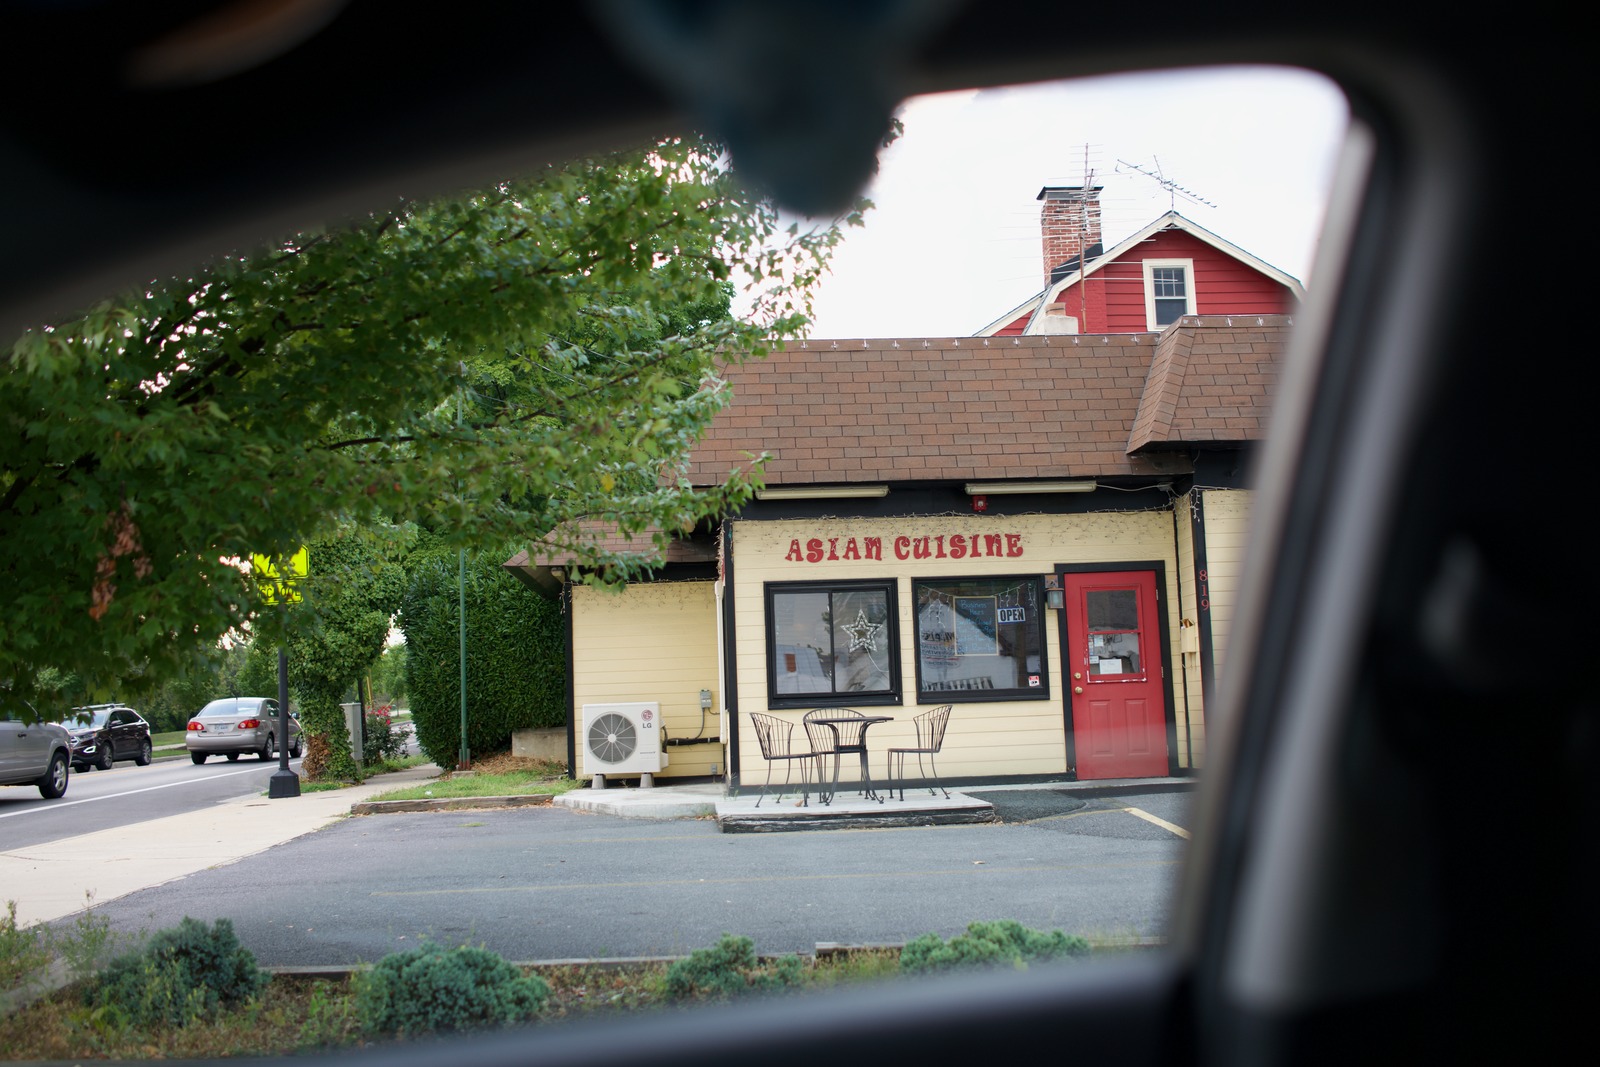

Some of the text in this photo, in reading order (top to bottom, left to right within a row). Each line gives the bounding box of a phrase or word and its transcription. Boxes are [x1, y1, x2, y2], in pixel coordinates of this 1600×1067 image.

[785, 534, 1023, 563] ASIAN CUISINE
[1199, 569, 1210, 611] 819
[1000, 608, 1024, 622] OPEN
